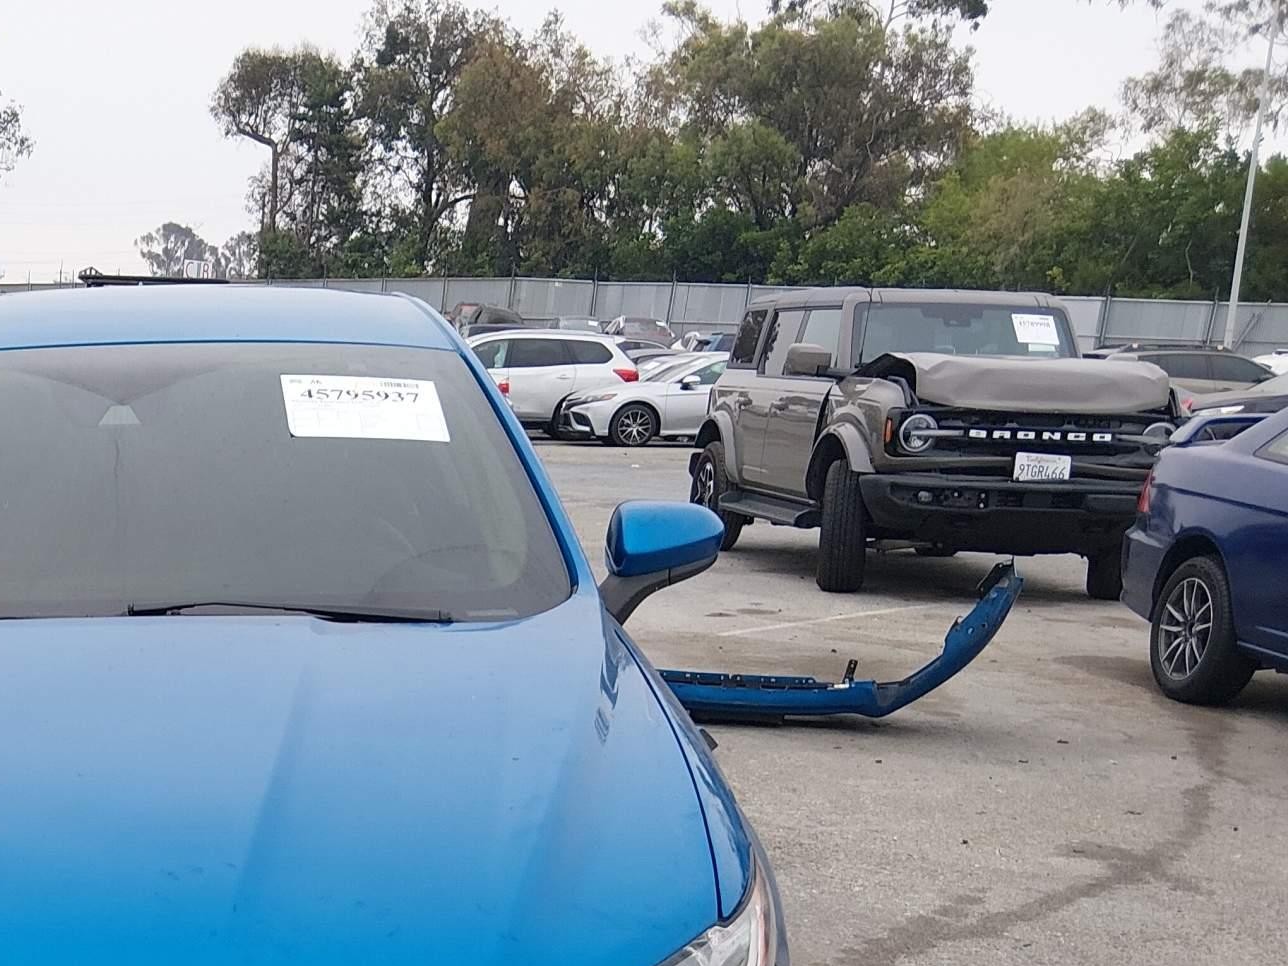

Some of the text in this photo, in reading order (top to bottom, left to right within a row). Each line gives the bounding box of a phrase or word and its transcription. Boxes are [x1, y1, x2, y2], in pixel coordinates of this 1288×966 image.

[300, 388, 420, 403] 45795937
[968, 429, 1113, 442] BRONCO
[1018, 463, 1066, 480] 9TGR466
